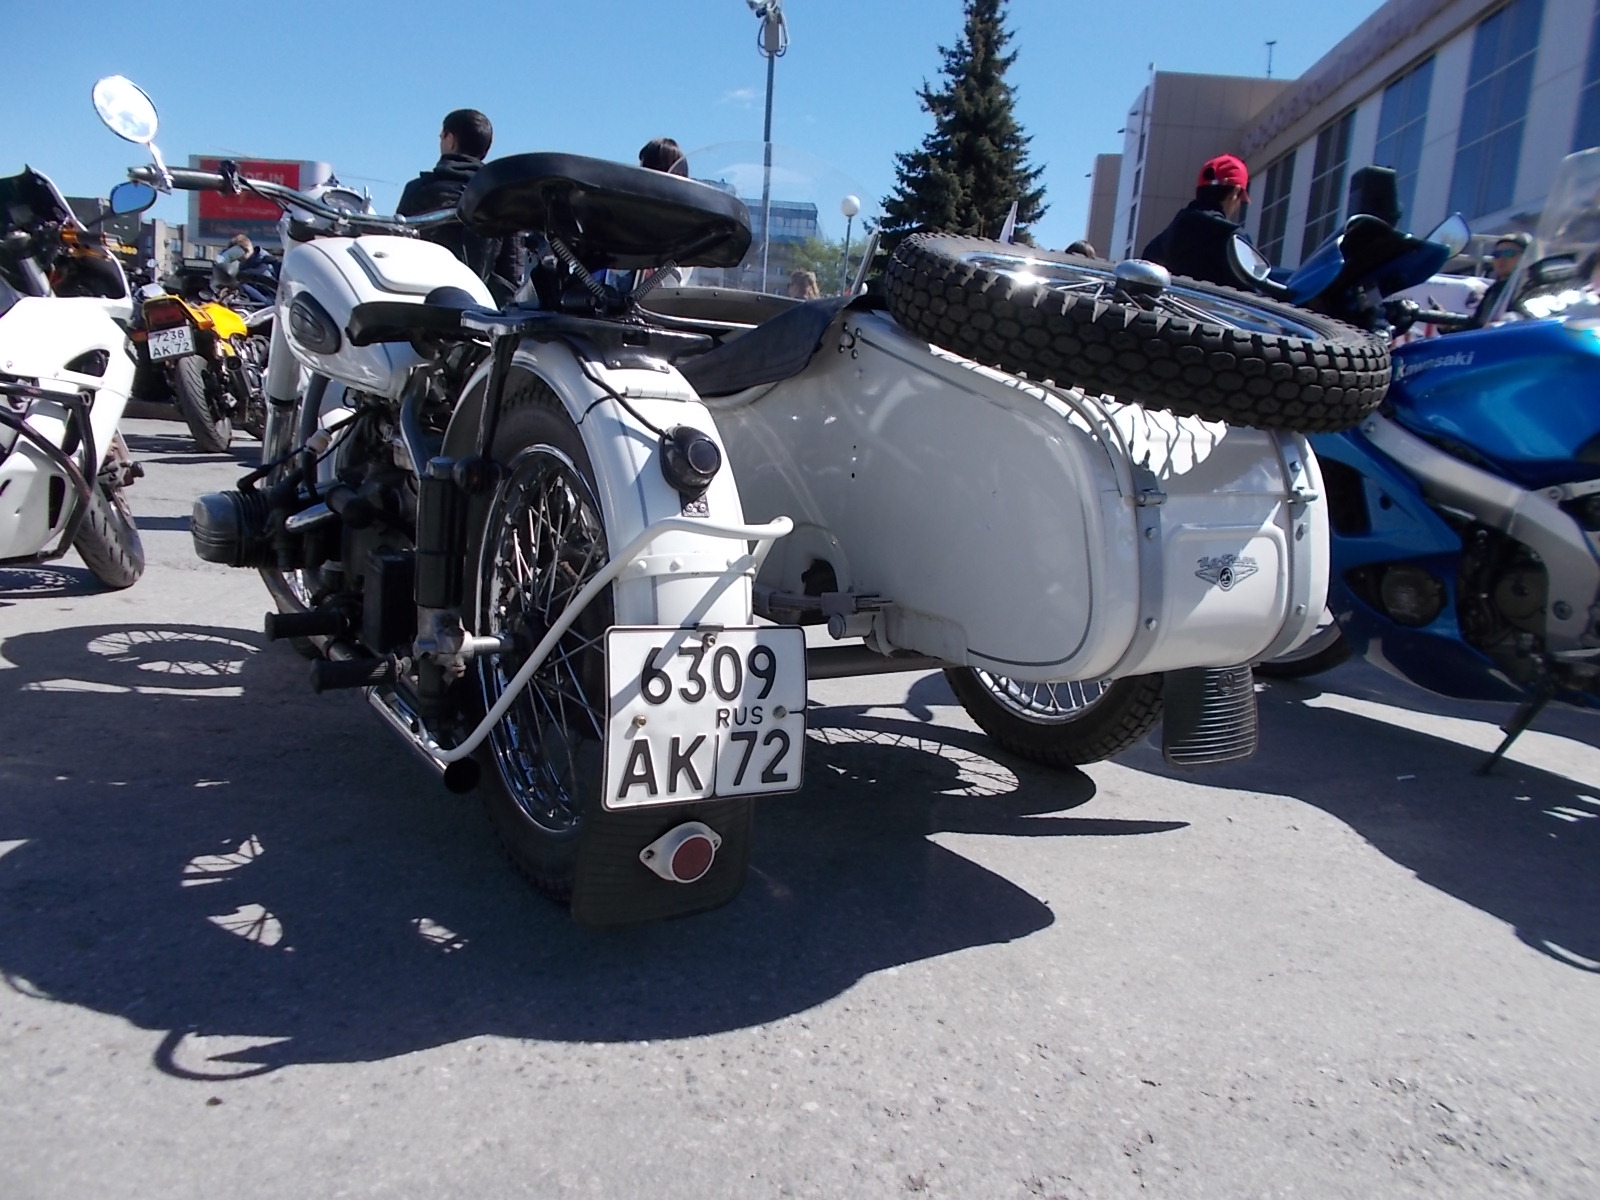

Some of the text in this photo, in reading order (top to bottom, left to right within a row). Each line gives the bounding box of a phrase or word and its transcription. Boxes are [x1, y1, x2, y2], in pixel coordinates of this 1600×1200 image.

[155, 329, 185, 343] 7238
[153, 341, 190, 357] AK 72
[641, 644, 777, 704] 6309
[716, 706, 763, 728] RUS
[618, 728, 790, 798] AK 72
